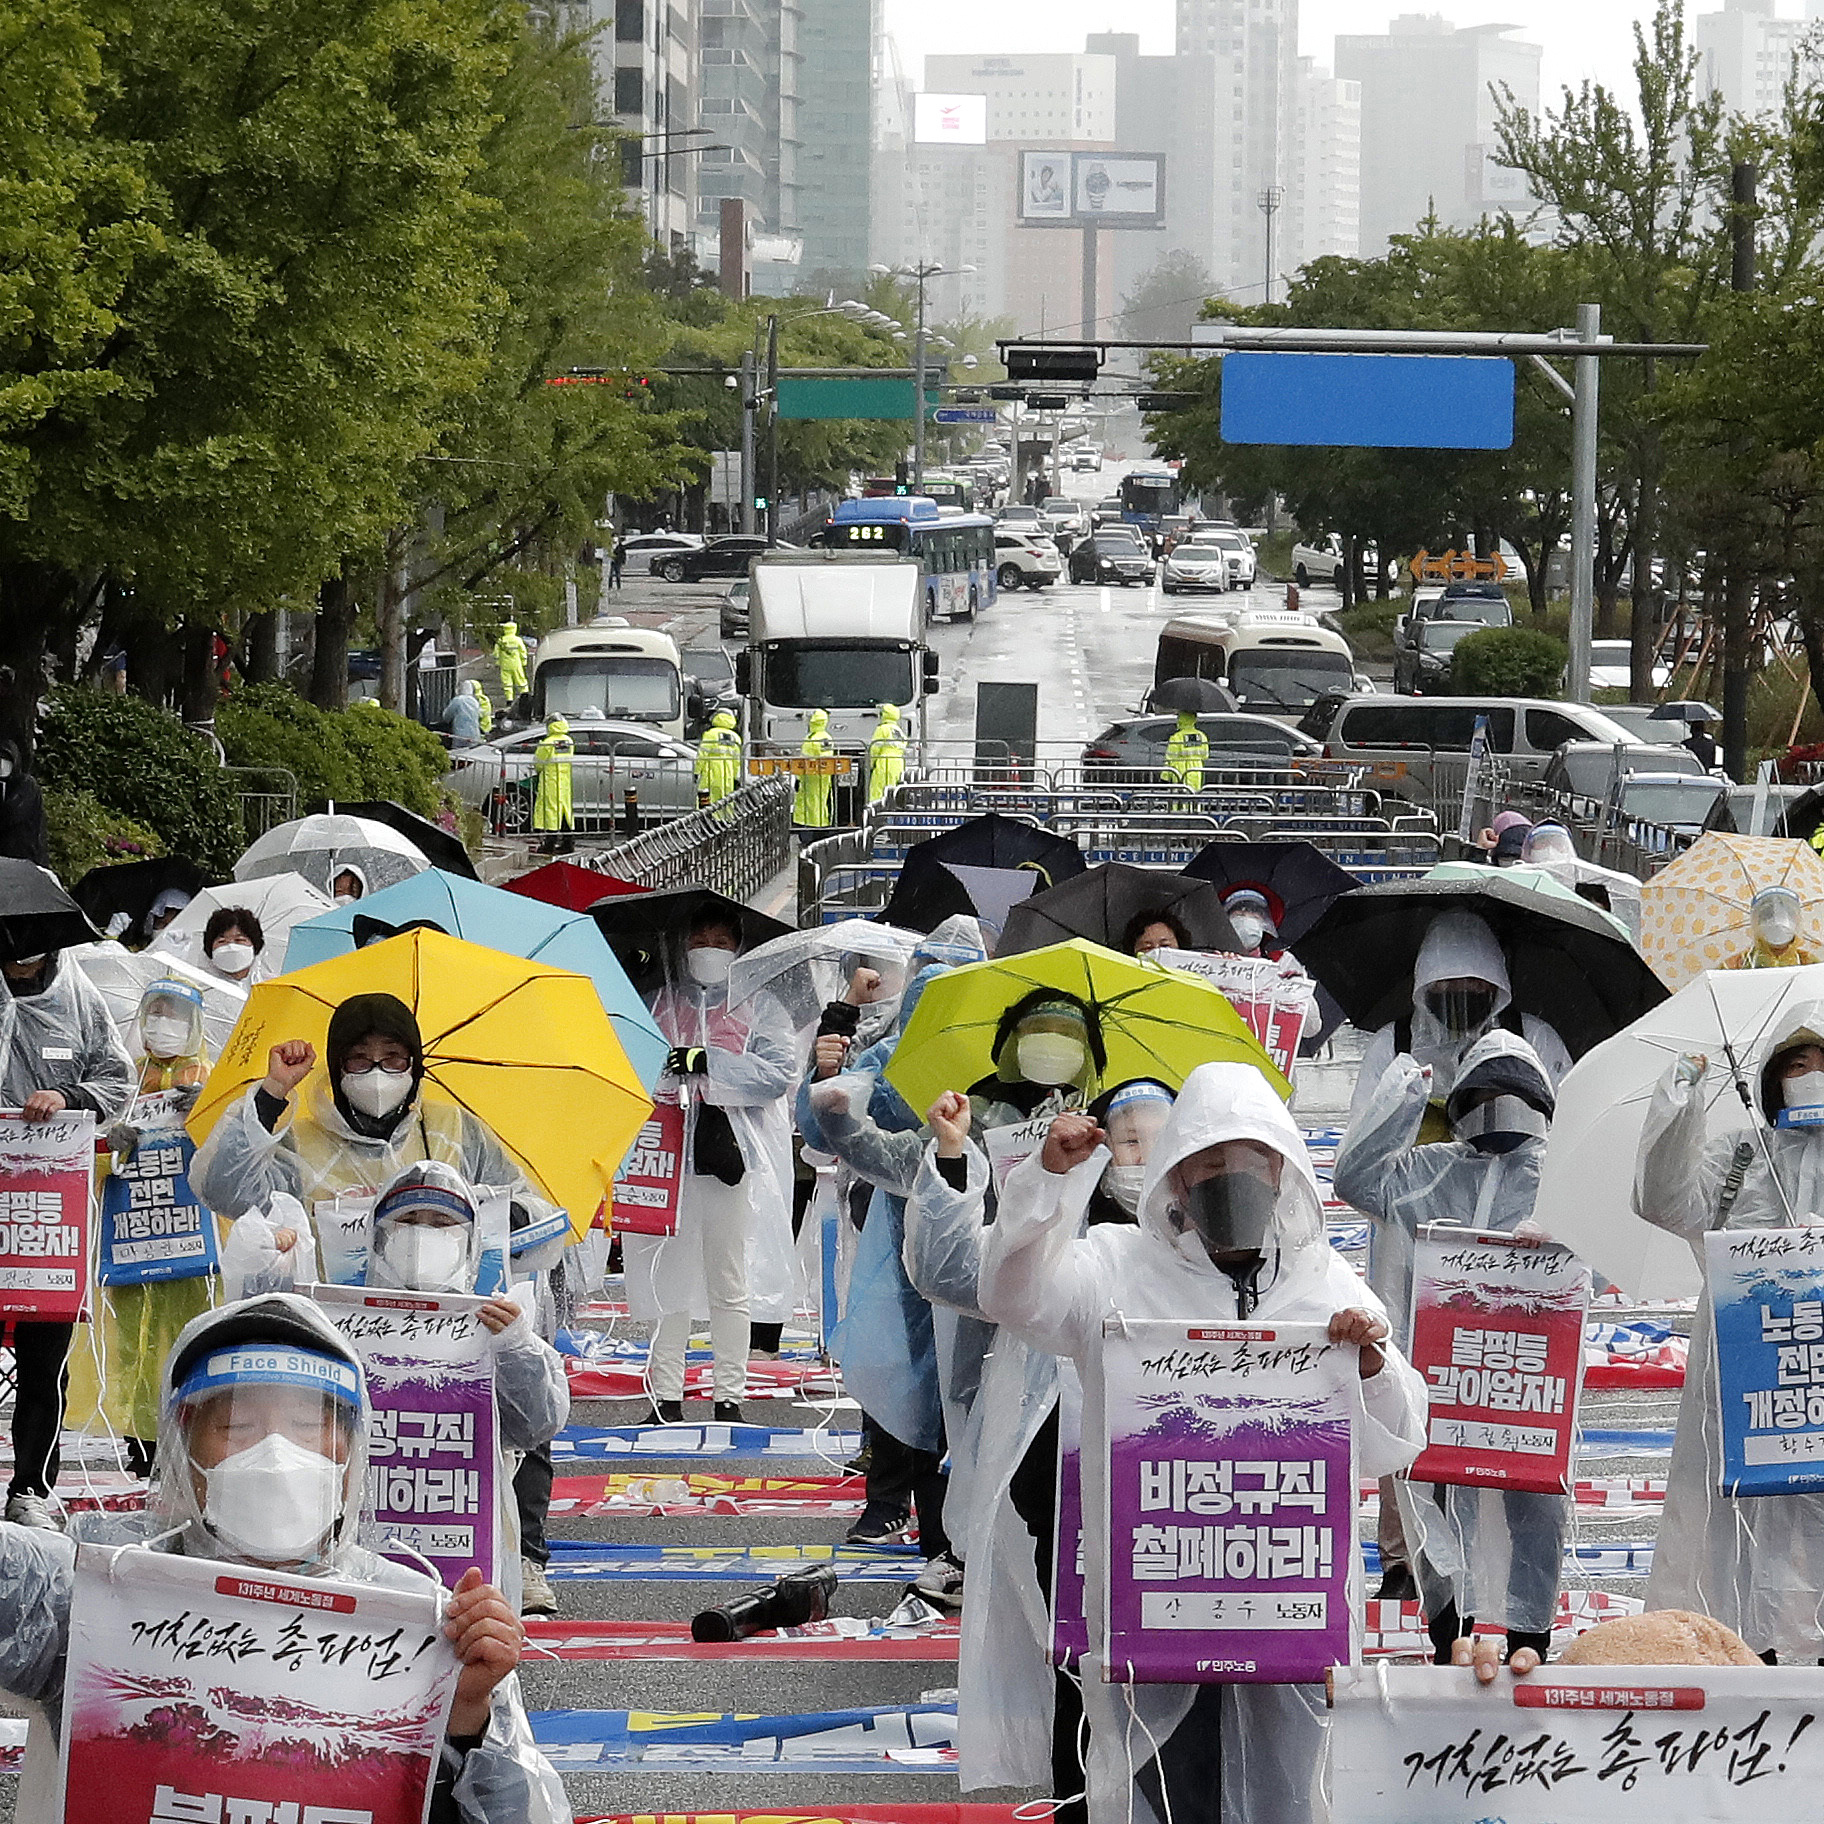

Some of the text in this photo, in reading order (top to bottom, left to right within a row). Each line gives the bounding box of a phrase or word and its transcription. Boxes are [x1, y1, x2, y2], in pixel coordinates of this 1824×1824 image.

[849, 526, 884, 540] 262
[129, 1178, 175, 1209] 전면
[112, 1205, 201, 1240] 개정하라!
[1140, 1348, 1227, 1382] 거침없는
[1451, 1326, 1550, 1374] 불평등
[229, 1355, 278, 1371] Face
[286, 1356, 344, 1382] Shield
[1426, 1365, 1567, 1415] 갈아엎자!
[1139, 1458, 1327, 1516] 비정규직
[429, 1532, 472, 1548] 노동자
[1132, 1523, 1334, 1581] 철폐하라!
[236, 1579, 336, 1610] 131주년 세계노동절
[1276, 1602, 1324, 1620] 노동자
[130, 1610, 266, 1662] 거침없는
[1543, 1687, 1676, 1709] 131주년 세계노동절
[1402, 1731, 1588, 1799] 거침없는
